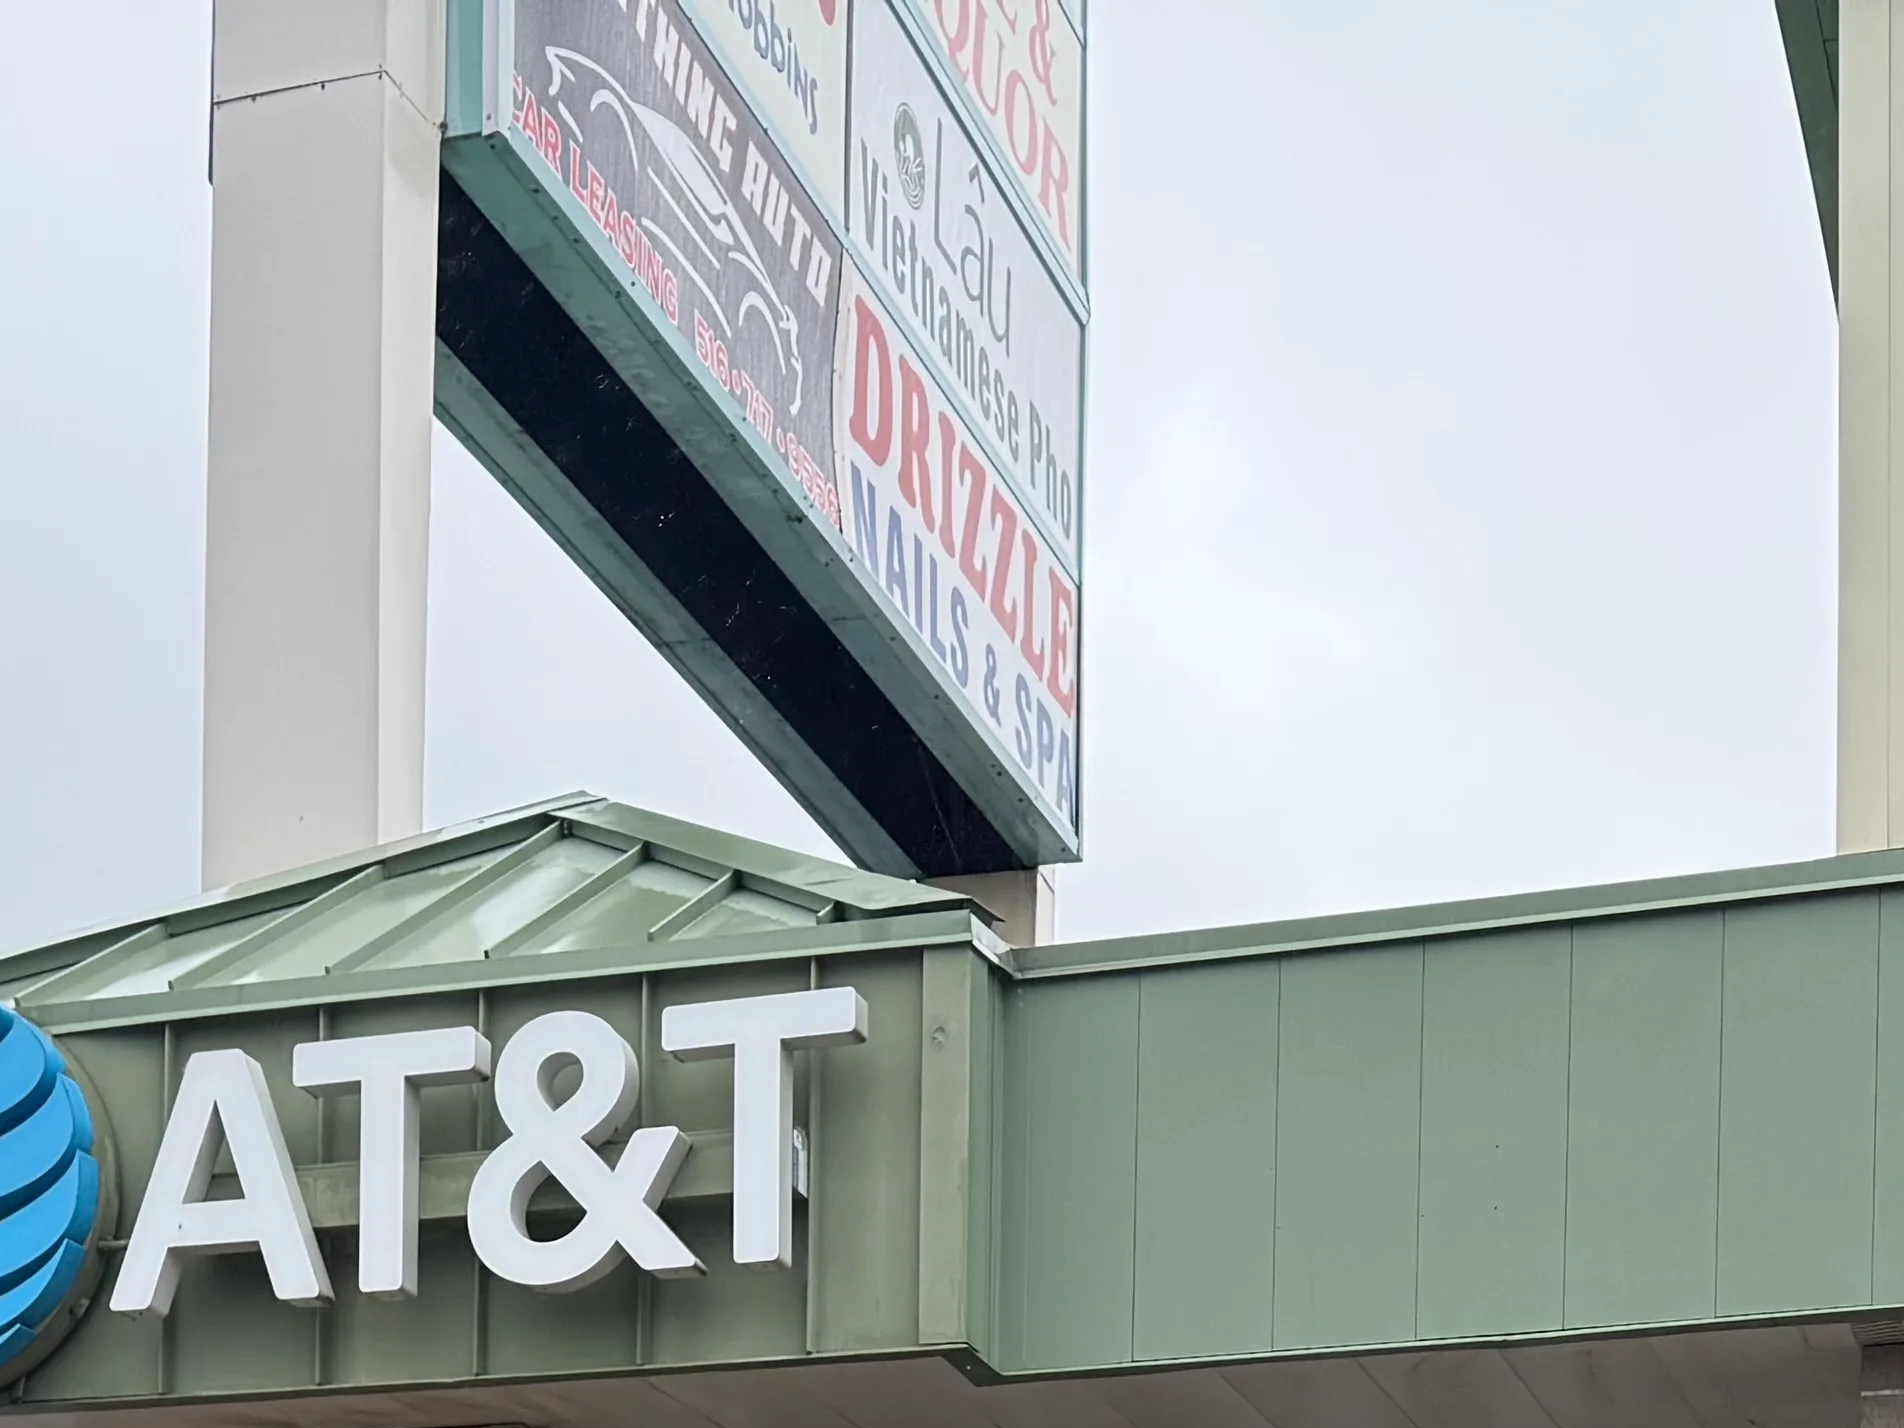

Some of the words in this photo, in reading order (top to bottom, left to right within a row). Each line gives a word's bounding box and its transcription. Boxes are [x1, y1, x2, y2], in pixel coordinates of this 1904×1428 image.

[741, 137, 832, 307] AUTO
[932, 0, 1071, 253] QUOR
[848, 294, 1075, 719] DRIZZLE
[860, 136, 1019, 463] Vietnamese
[1029, 399, 1072, 541] Pho
[850, 459, 970, 689] NAILS
[982, 643, 1001, 729] &
[1015, 672, 1075, 828] SPA
[109, 985, 868, 1319] AT&T
